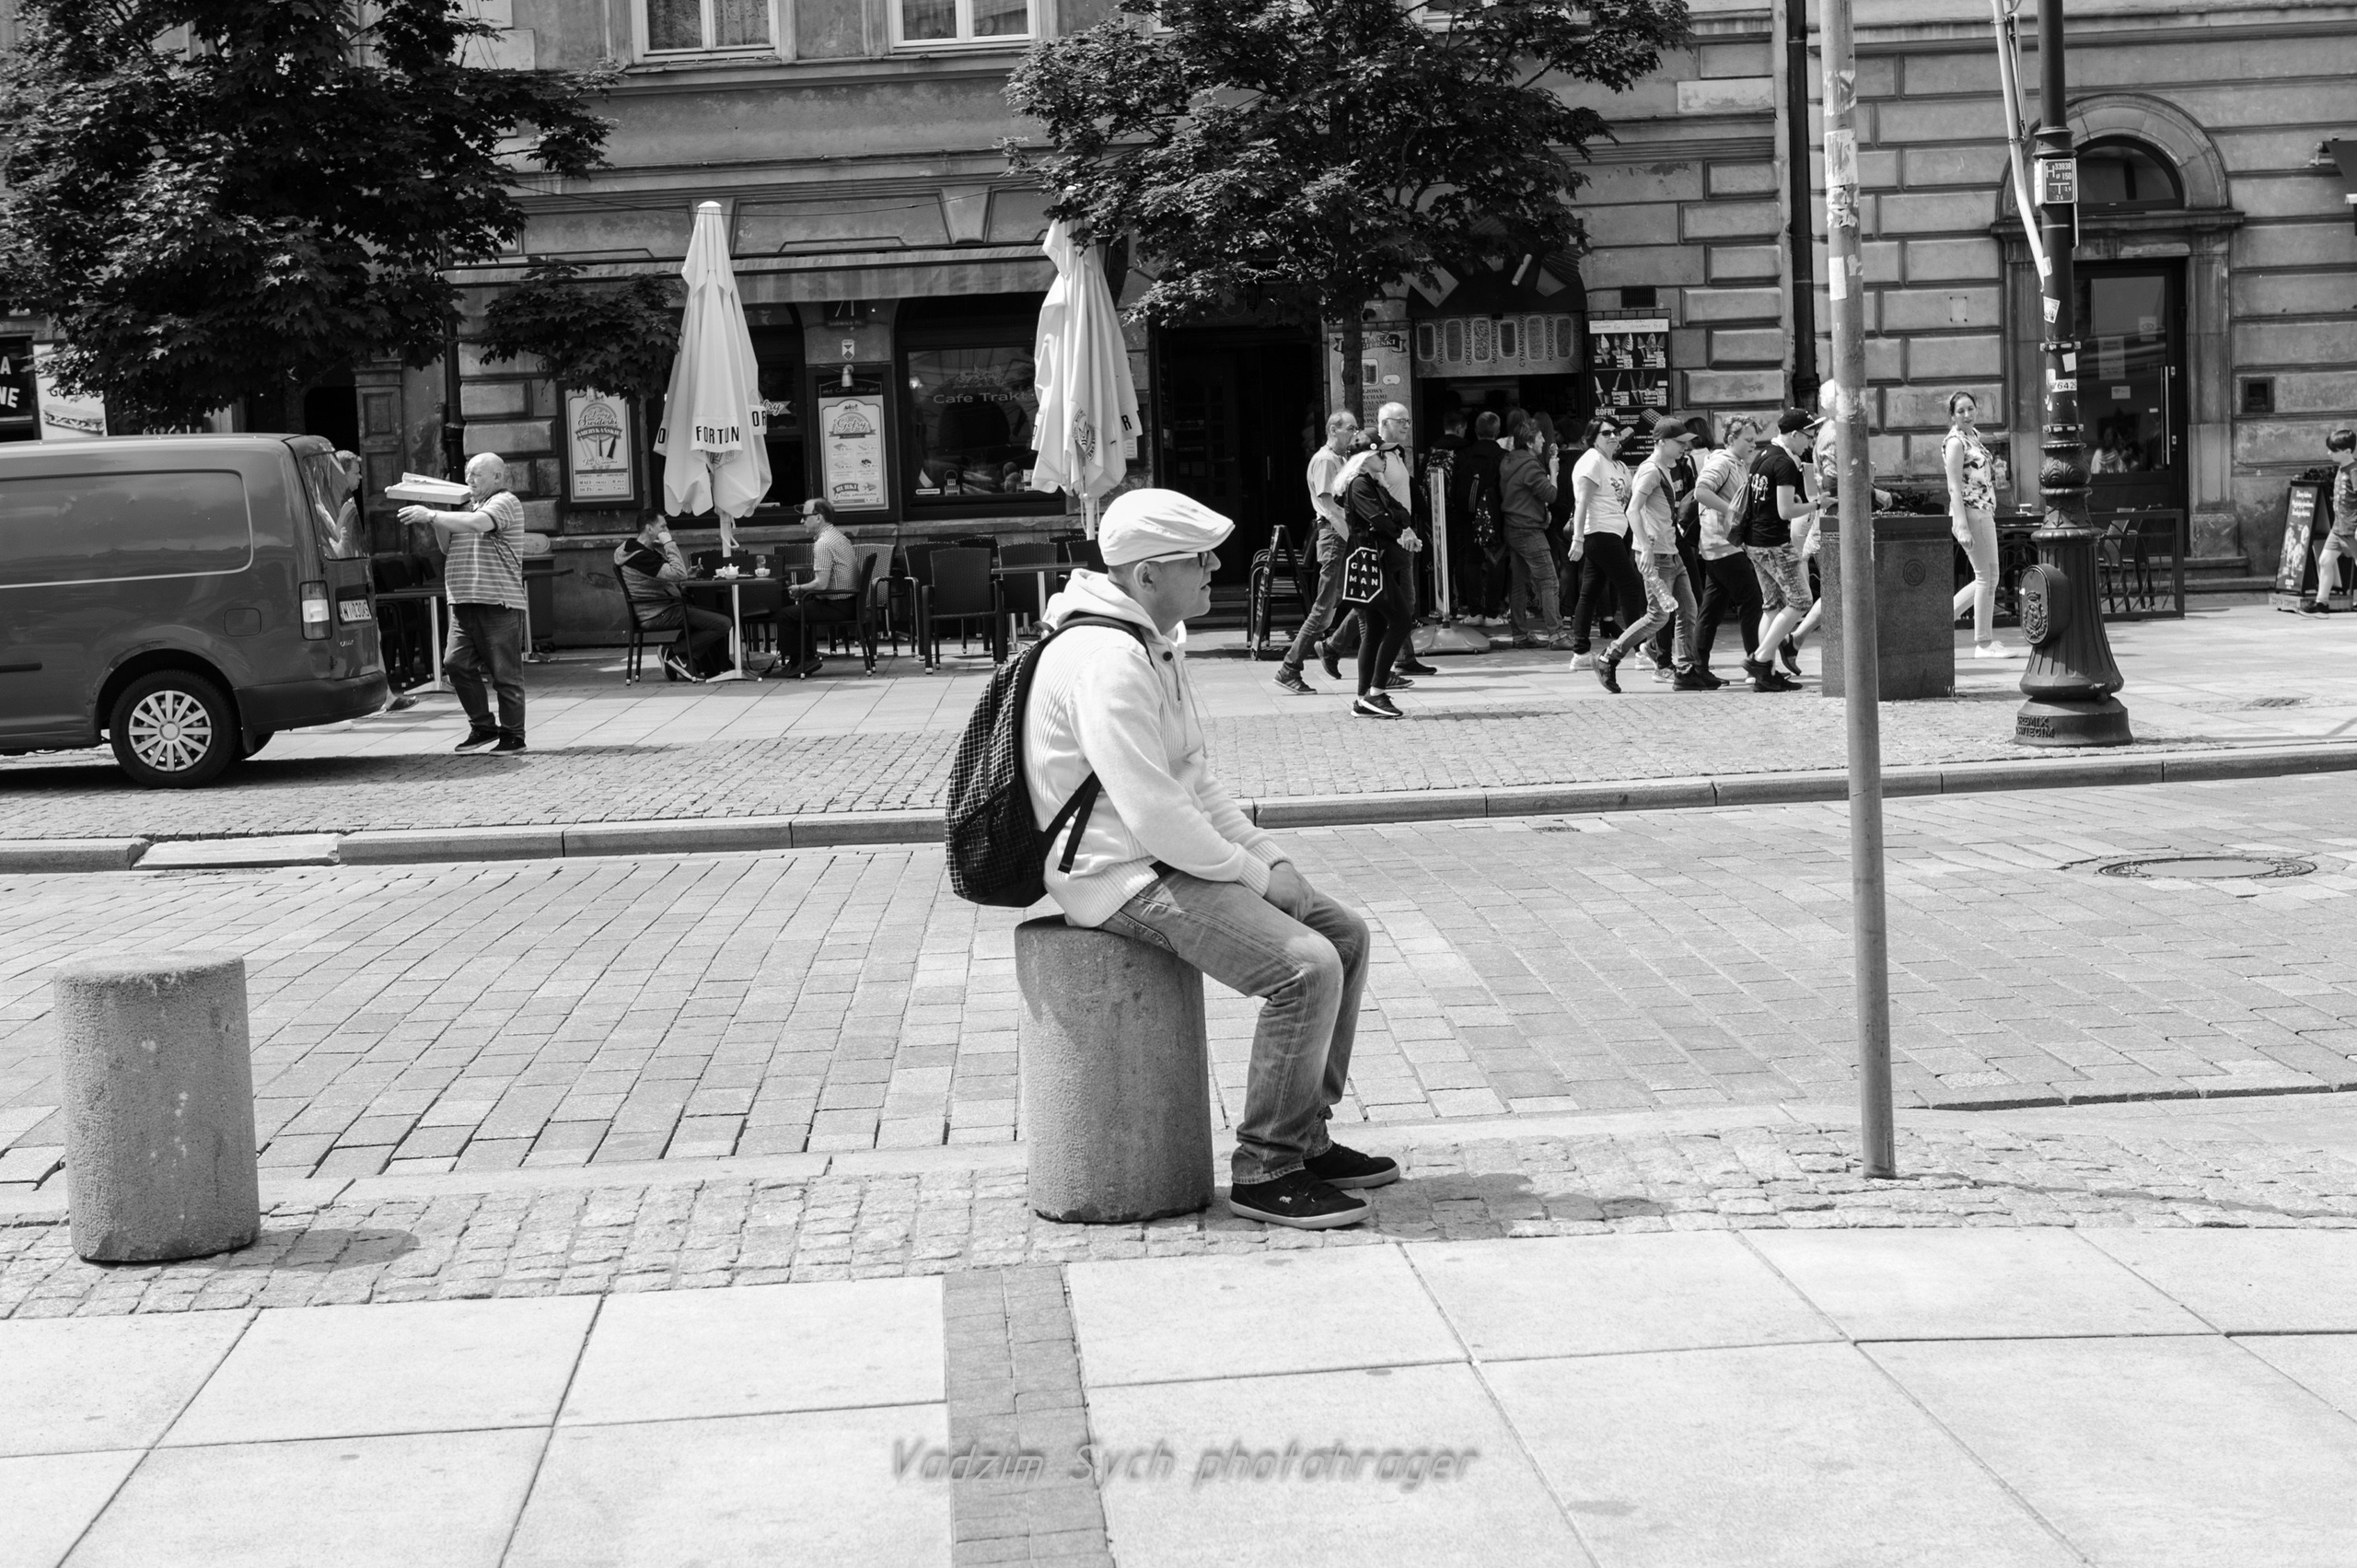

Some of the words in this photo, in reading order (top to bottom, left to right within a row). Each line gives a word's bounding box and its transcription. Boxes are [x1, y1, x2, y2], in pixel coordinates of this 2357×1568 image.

[933, 393, 973, 404] Cafe
[979, 391, 1028, 402] Trakt
[1595, 408, 1617, 416] GOFRY
